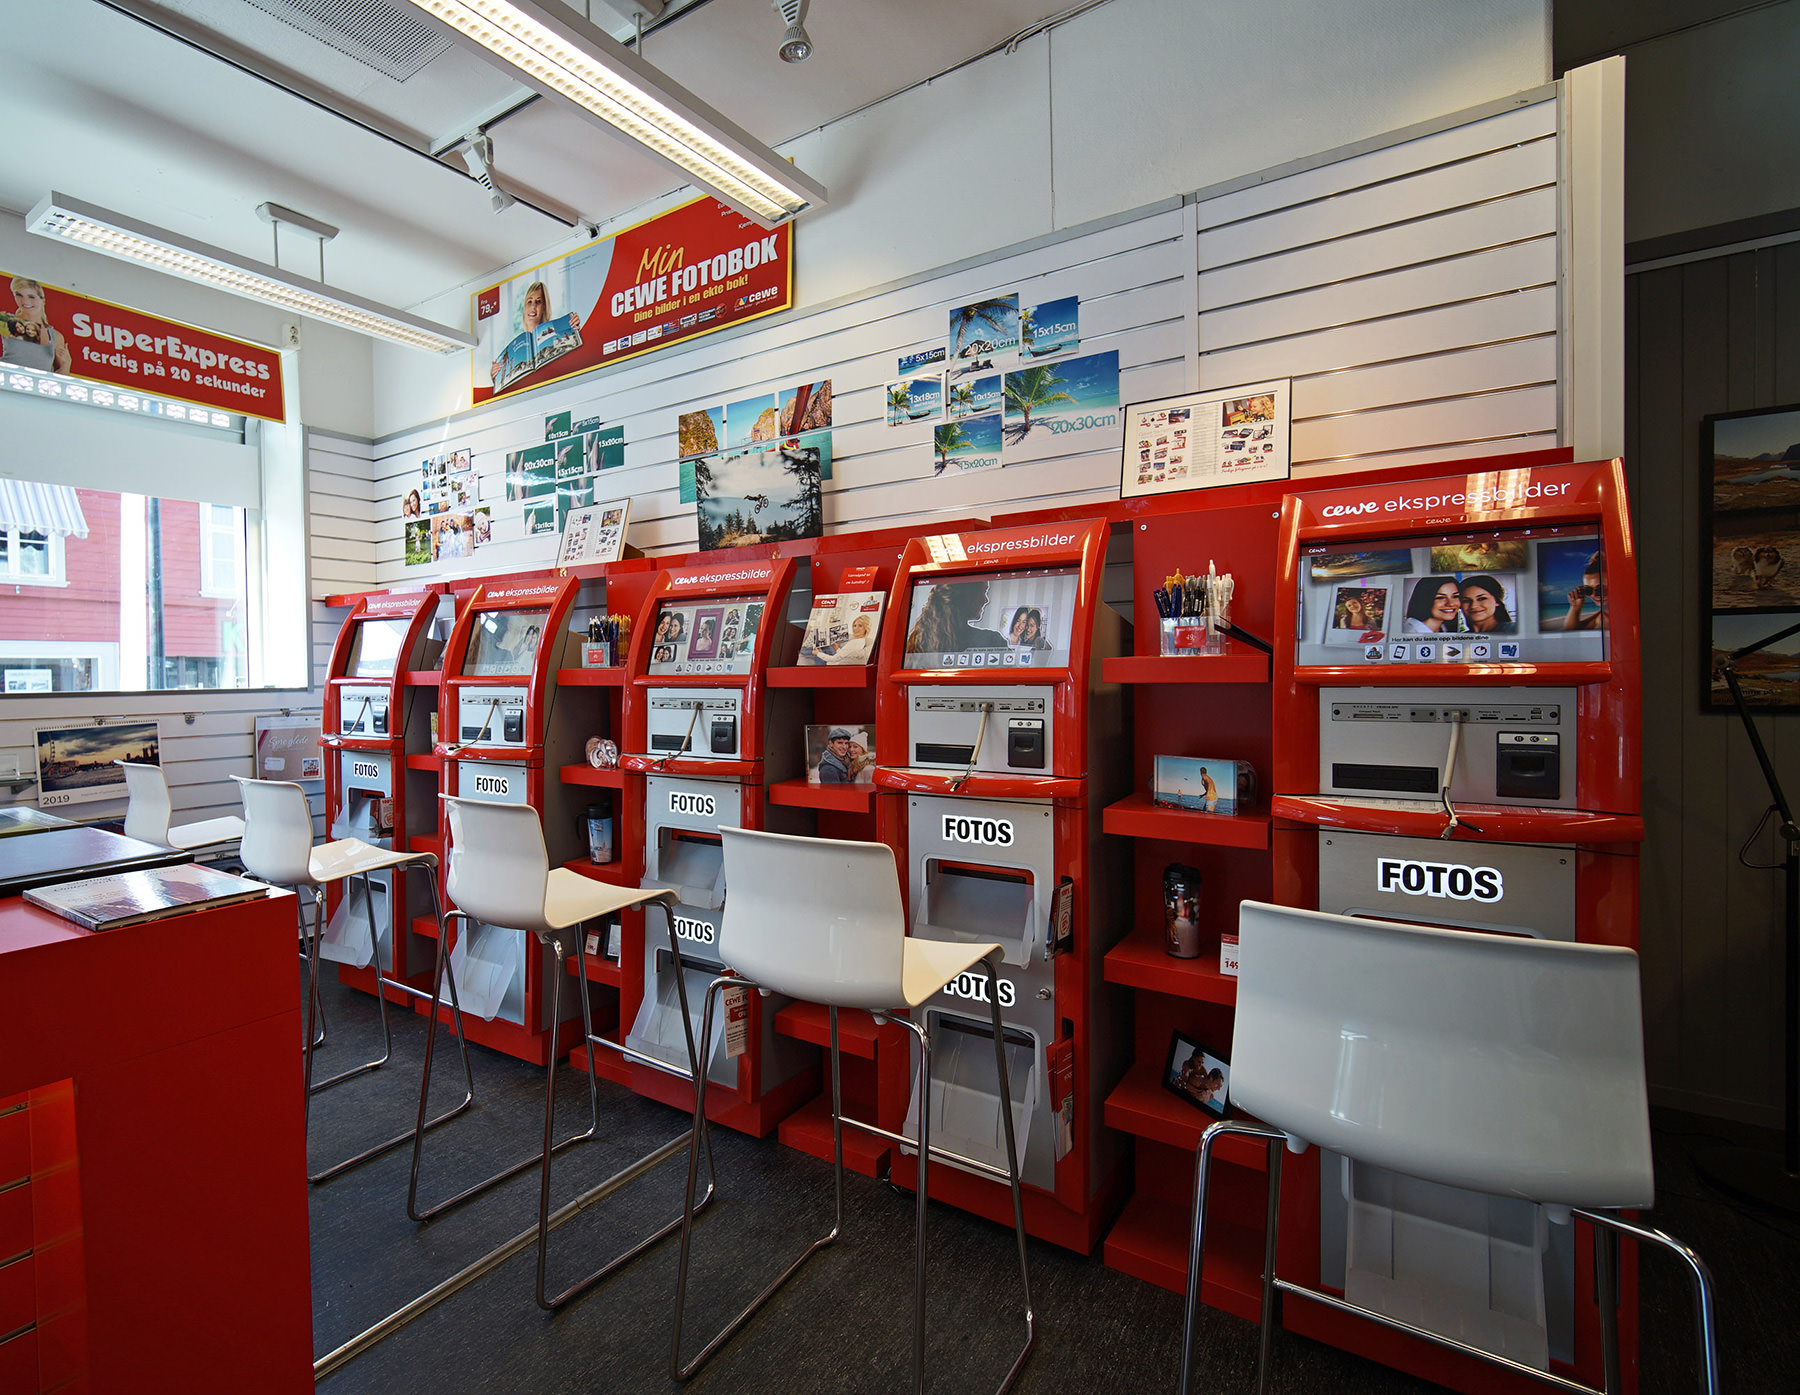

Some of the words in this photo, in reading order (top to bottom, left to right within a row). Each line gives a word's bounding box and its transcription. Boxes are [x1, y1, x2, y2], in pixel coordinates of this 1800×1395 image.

[636, 244, 684, 284] Min
[611, 274, 668, 318] CEWE
[671, 233, 779, 297] FOTOBOK
[633, 307, 653, 323] Dine
[655, 298, 681, 315] bilder
[683, 295, 687, 306] i
[689, 292, 701, 304] en
[703, 284, 724, 299] ekte
[726, 273, 749, 294] bok!
[749, 286, 778, 303] cewe
[1032, 321, 1076, 339] 15x15cm
[72, 312, 271, 380] SuperExpress
[965, 336, 1017, 356] 20x20cm
[915, 348, 945, 363] 5x15cm
[82, 346, 138, 374] ferdig
[143, 361, 166, 377] på
[170, 366, 191, 382] 20
[195, 374, 266, 398] sekunder
[909, 391, 940, 404] 13x18cm
[973, 391, 1001, 402] 10x15cm
[1051, 413, 1117, 435] 20x30cm
[548, 430, 569, 440] 10x15cm
[598, 436, 624, 449] 15x20cm
[523, 457, 554, 472] 20x30cm
[558, 465, 583, 477] 15x15cm
[959, 457, 998, 471] 15x20cm
[1322, 500, 1380, 518] cewe
[1384, 480, 1571, 513] ekspressbilder
[967, 533, 1076, 554] ekspressbilder
[674, 575, 698, 585] cewe
[699, 569, 771, 584] ekspressbilder
[505, 585, 559, 597] ekspressbilder
[354, 763, 378, 778] FOTOS
[476, 777, 508, 794] FOTOS
[42, 794, 70, 805] 2019
[670, 793, 714, 815] FOTOS
[944, 817, 1012, 844] FOTOS
[1382, 862, 1499, 900] FOTOS
[673, 918, 713, 942] OTOS
